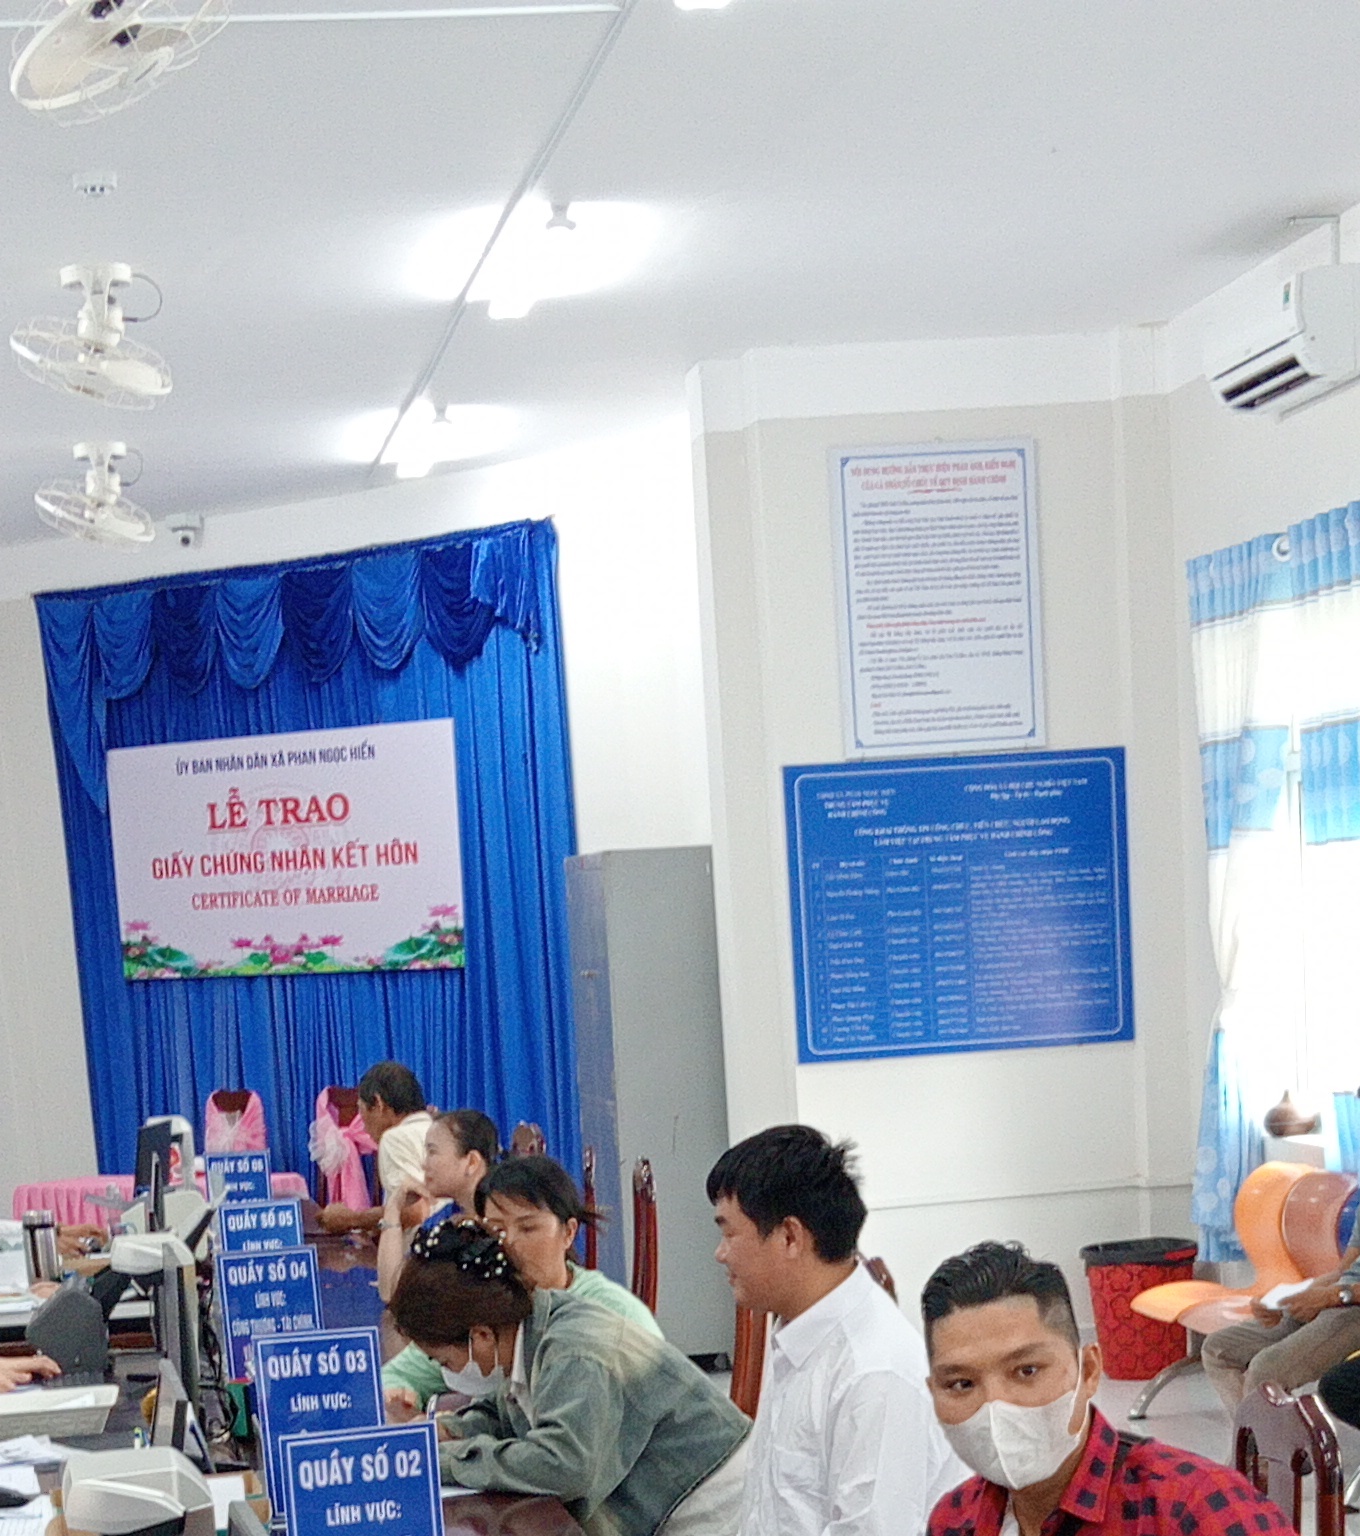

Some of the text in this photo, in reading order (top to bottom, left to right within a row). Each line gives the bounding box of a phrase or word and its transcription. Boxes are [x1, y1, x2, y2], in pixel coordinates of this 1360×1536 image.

[207, 786, 351, 830] LỄ TRAO
[201, 851, 265, 876] CHỨNG
[271, 844, 326, 875] NHẬN
[332, 837, 368, 868] KẾT
[376, 838, 419, 866] HÔN
[191, 883, 381, 911] CERTIFICATE OF MARRIAGE
[260, 1206, 276, 1229] SỐ
[278, 1209, 294, 1227] 05
[267, 1255, 287, 1282] SỐ
[289, 1260, 309, 1280] 04
[316, 1342, 341, 1376] SỐ
[344, 1348, 368, 1374] 03
[361, 1442, 390, 1482] SỐ
[395, 1448, 422, 1479] 02
[364, 1498, 403, 1525] VỰC:
